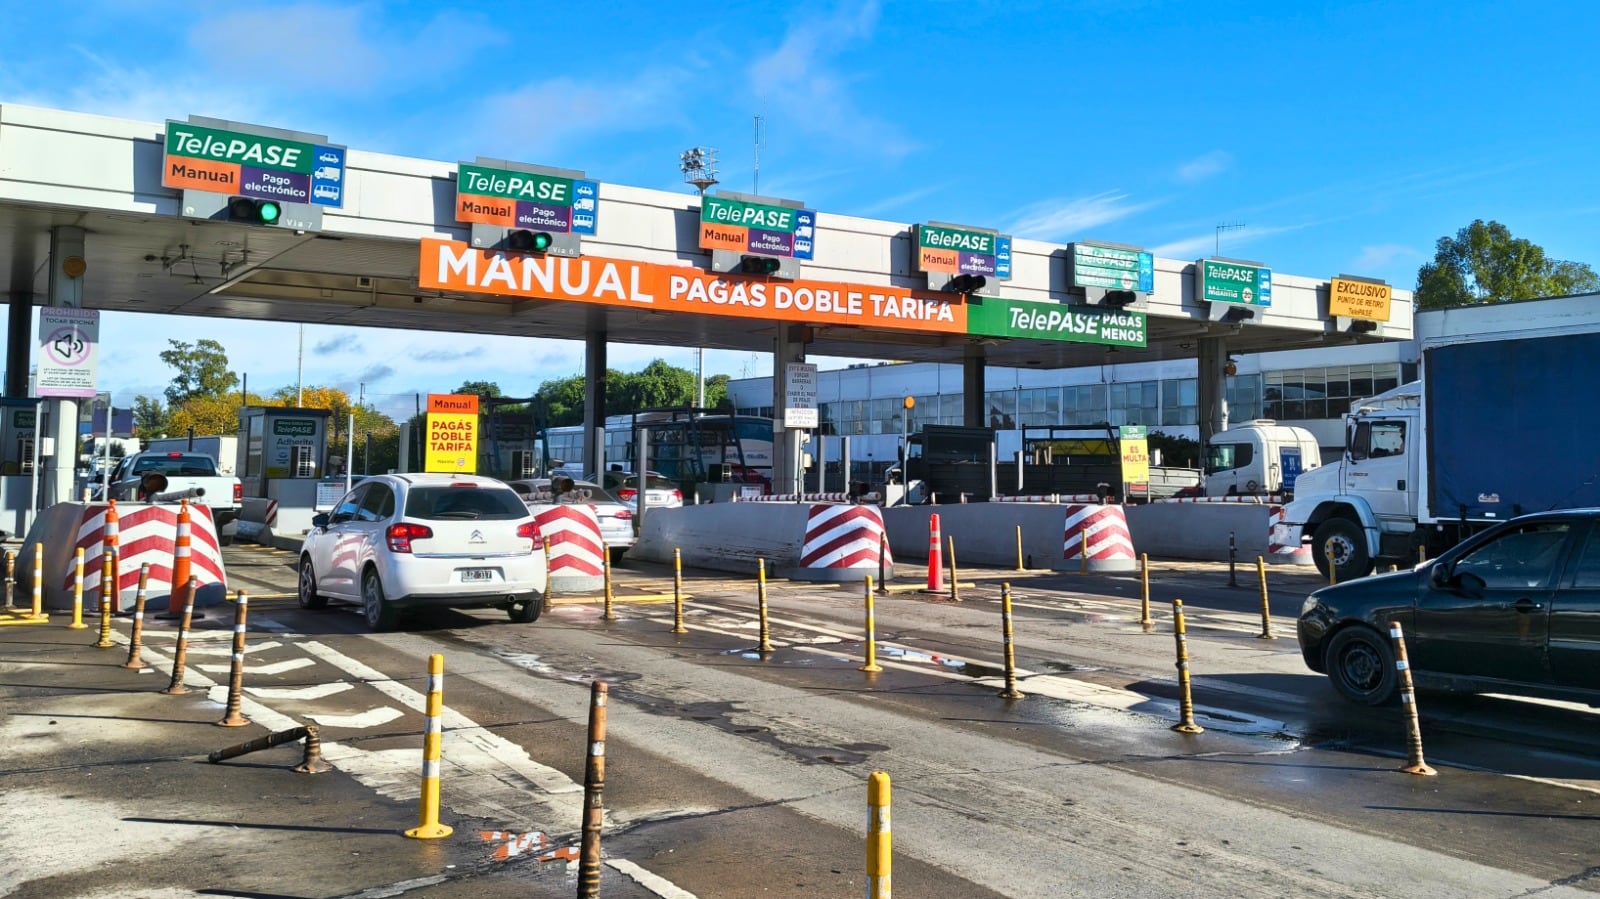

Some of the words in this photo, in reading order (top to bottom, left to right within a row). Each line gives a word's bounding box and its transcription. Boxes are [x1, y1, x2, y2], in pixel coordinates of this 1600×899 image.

[175, 131, 301, 168] TelePASE
[171, 163, 234, 184] Manual
[262, 173, 291, 186] Pago
[245, 181, 306, 198] electrónico
[466, 171, 567, 201] TelePASE
[462, 201, 511, 217] Manual
[533, 207, 555, 217] Pago
[708, 202, 791, 228] TelePASE
[519, 214, 567, 228] electrónico
[705, 229, 744, 243] Manual
[762, 233, 781, 243] Pago
[925, 229, 989, 251] TelePASE
[751, 242, 790, 252] electrónico
[923, 253, 956, 266] Manual
[970, 256, 985, 265] Pago
[1208, 265, 1254, 282] TelePASE
[437, 244, 654, 304] MANUAL
[774, 285, 863, 315] DOBLE
[868, 294, 955, 323] TARIFA
[1337, 281, 1387, 299] EXCLUSIVO
[1337, 295, 1355, 305] PUNTO
[1356, 298, 1364, 306] DE
[1365, 299, 1384, 309] RETIRO
[42, 307, 98, 318] PROHIBIDO
[1009, 307, 1100, 335] TelePASE
[1102, 313, 1142, 328] PAGAS
[1101, 327, 1143, 342] MENOS
[434, 399, 472, 409] Manual
[432, 419, 472, 431] PAGÁS
[431, 431, 472, 441] DOBLE
[430, 442, 473, 451] TARIFA
[1129, 445, 1139, 454] ES
[1123, 454, 1147, 463] MULTA
